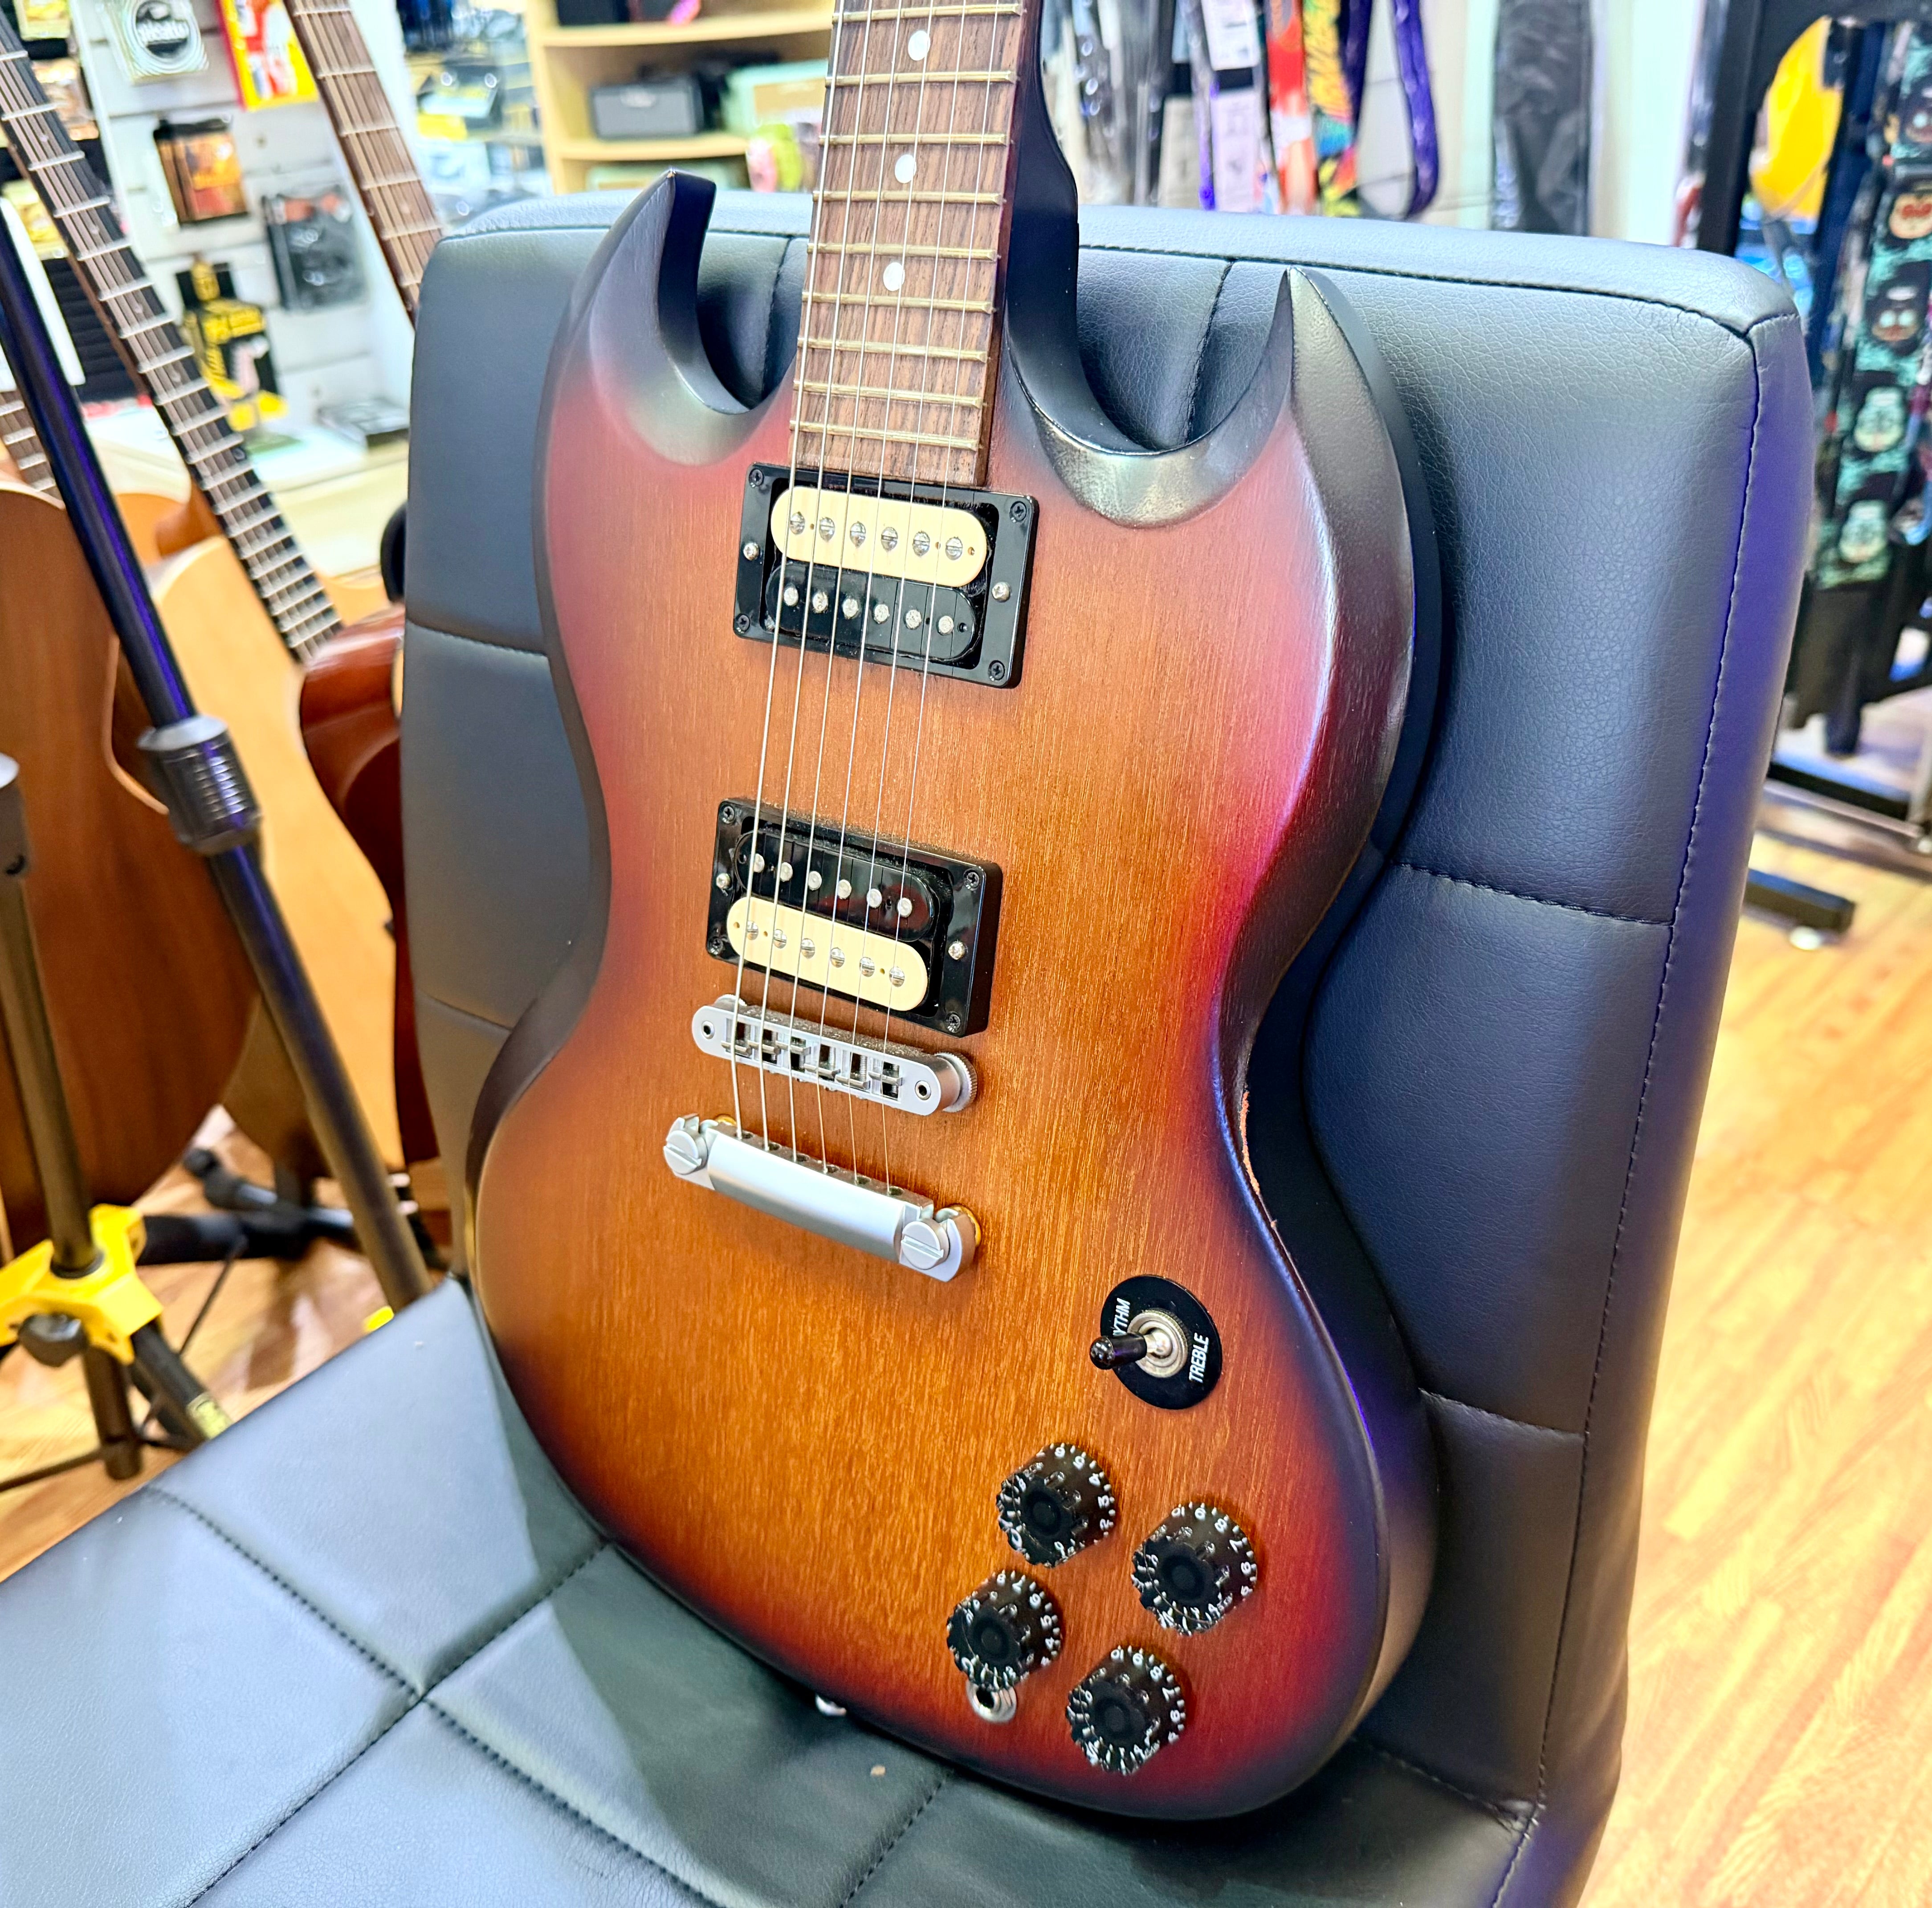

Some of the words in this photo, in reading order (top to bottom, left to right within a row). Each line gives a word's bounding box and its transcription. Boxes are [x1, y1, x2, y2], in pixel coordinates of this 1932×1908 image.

[1113, 1297, 1130, 1336] YTHM
[1189, 1332, 1209, 1383] TREBLE
[1073, 1455, 1085, 1469] 5
[1088, 1473, 1101, 1487] 4
[1097, 1495, 1110, 1508] 3
[1100, 1519, 1110, 1530] 2
[1171, 1506, 1185, 1517] 10
[1214, 1518, 1227, 1533] 8
[1229, 1539, 1243, 1553] 7
[997, 1573, 1006, 1586] 8
[1012, 1579, 1023, 1594] 7
[1040, 1614, 1052, 1630] 5
[1045, 1637, 1055, 1650] 4
[1110, 1649, 1124, 1662] 10
[1149, 1666, 1162, 1682] 8
[1162, 1687, 1175, 1701] 7
